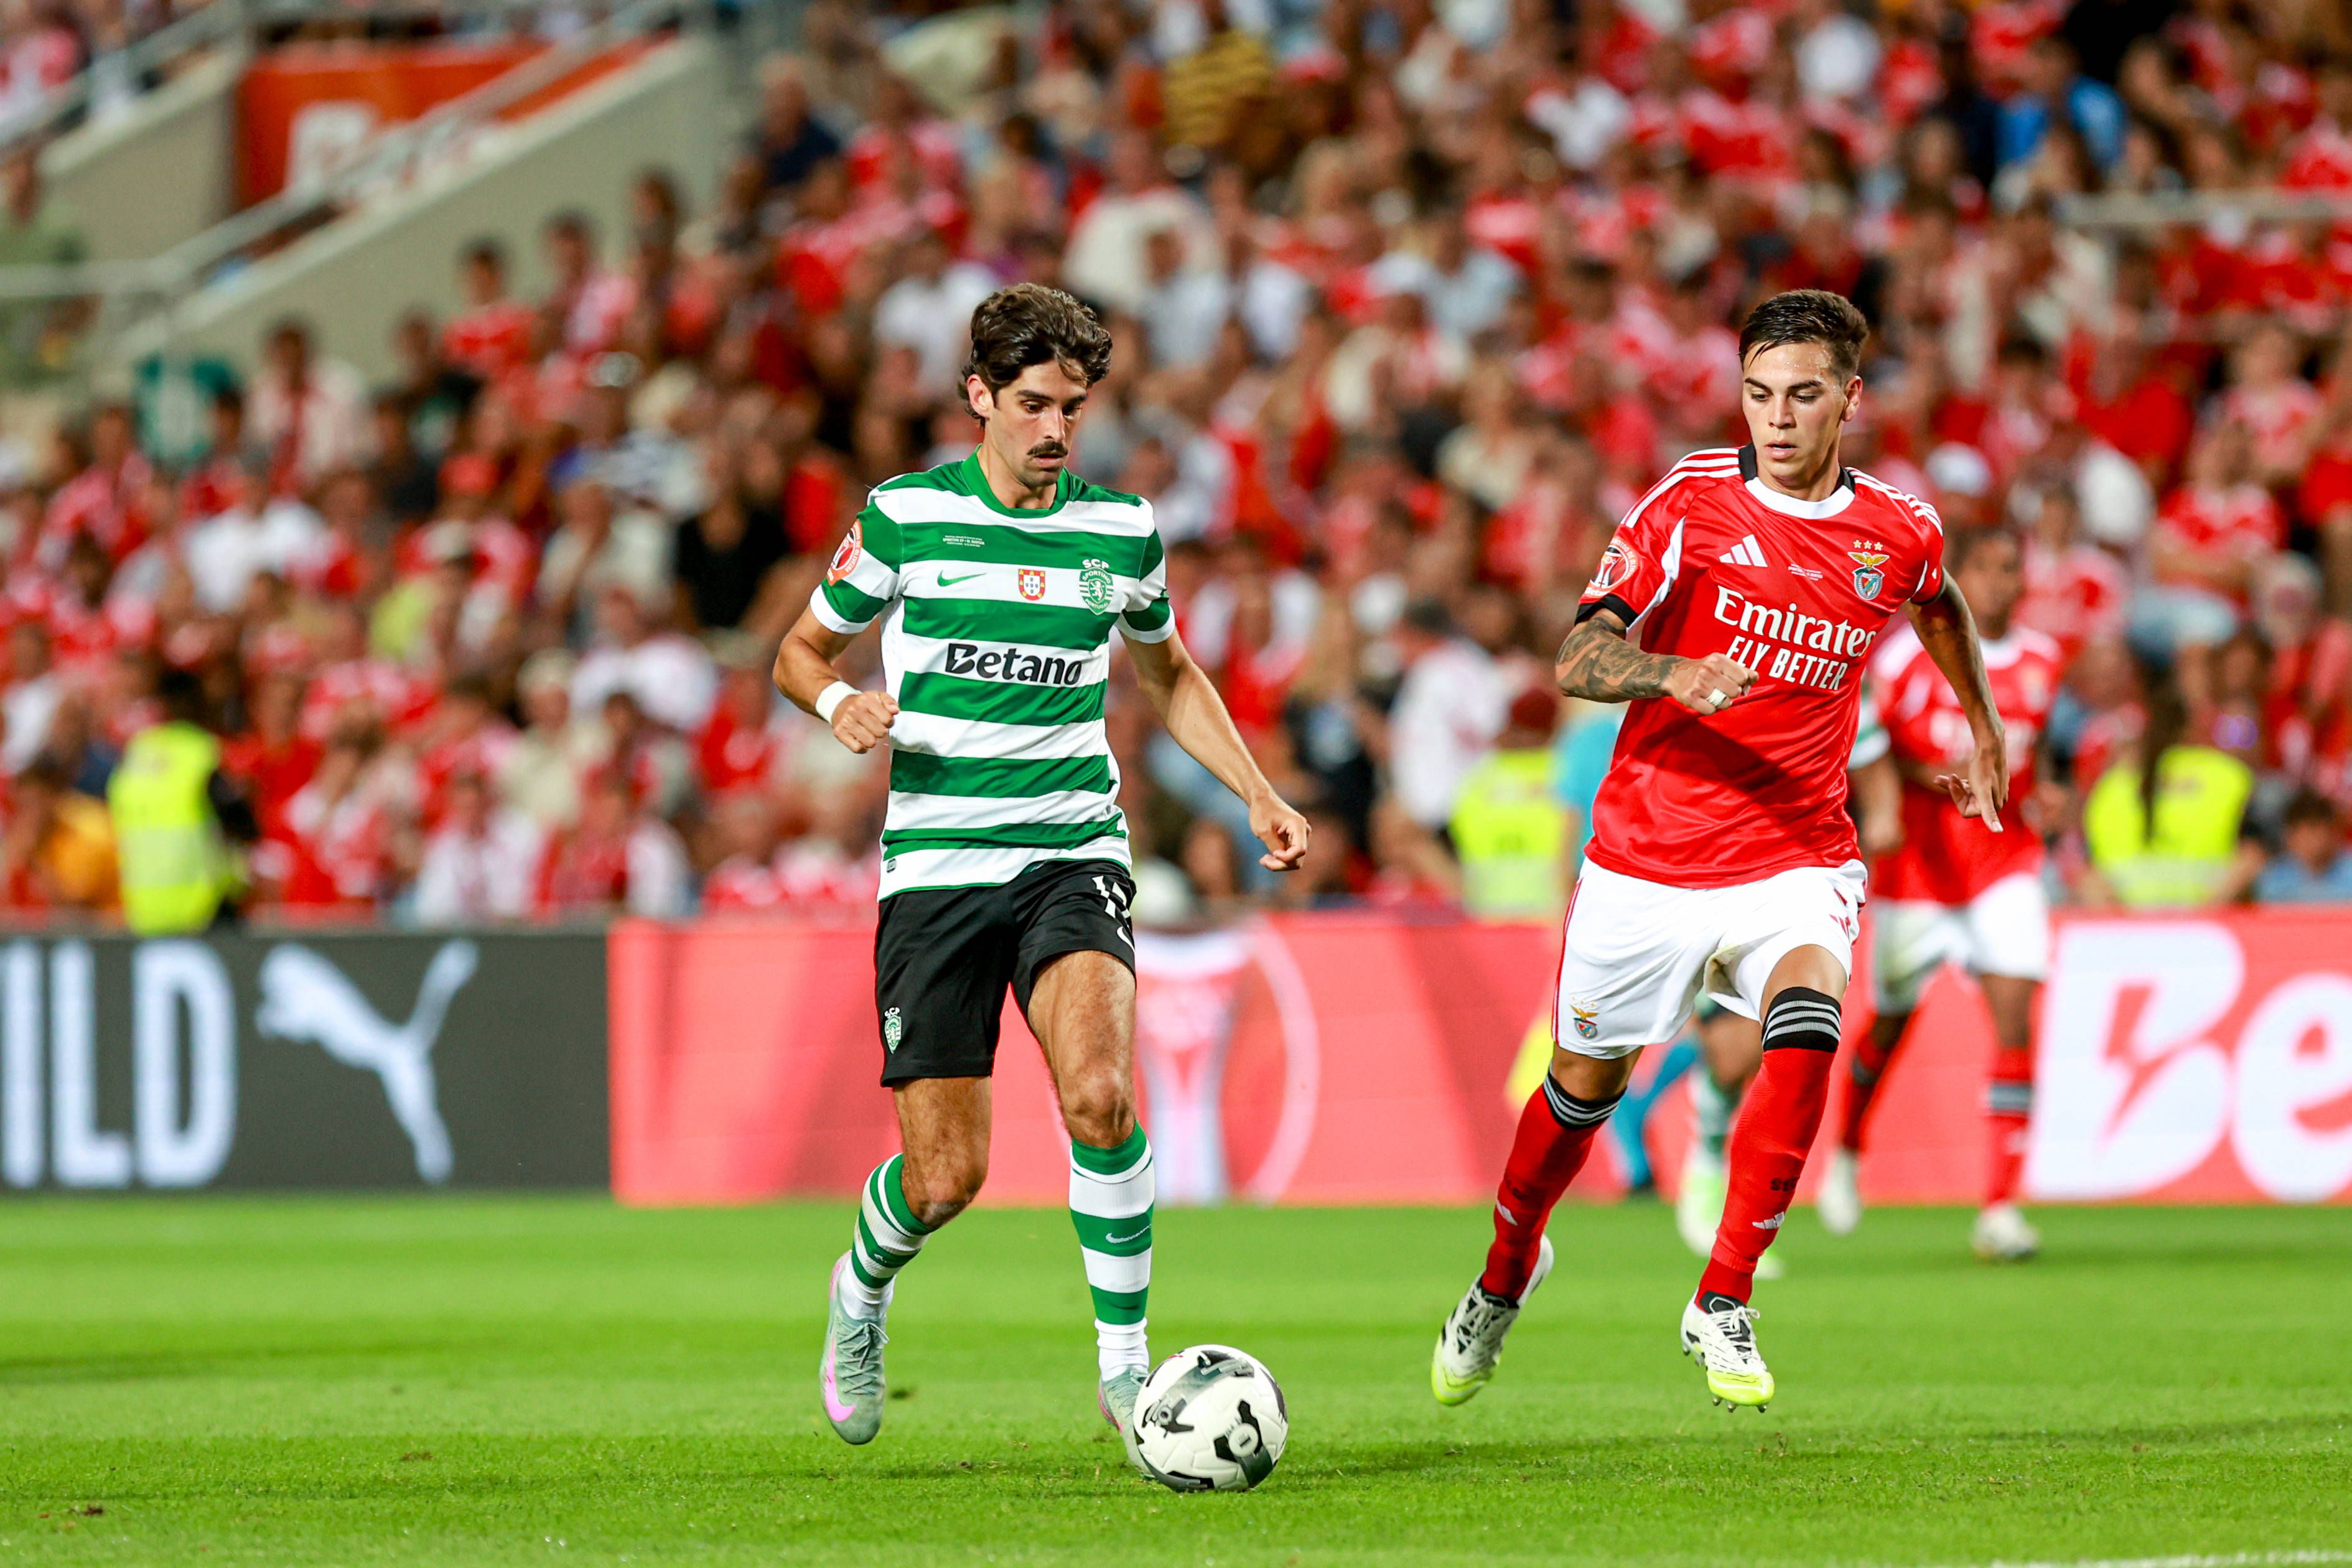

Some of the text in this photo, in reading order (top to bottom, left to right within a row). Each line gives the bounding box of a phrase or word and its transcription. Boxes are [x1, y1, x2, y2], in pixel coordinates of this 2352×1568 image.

[1082, 559, 1110, 569] SCP
[1714, 585, 1877, 657] Emirates
[945, 643, 1083, 686] Betano
[1725, 635, 1849, 691] FLY BETTER
[884, 1007, 900, 1019] SCP
[0, 937, 238, 1188] ILD
[2030, 922, 2352, 1202] Be
